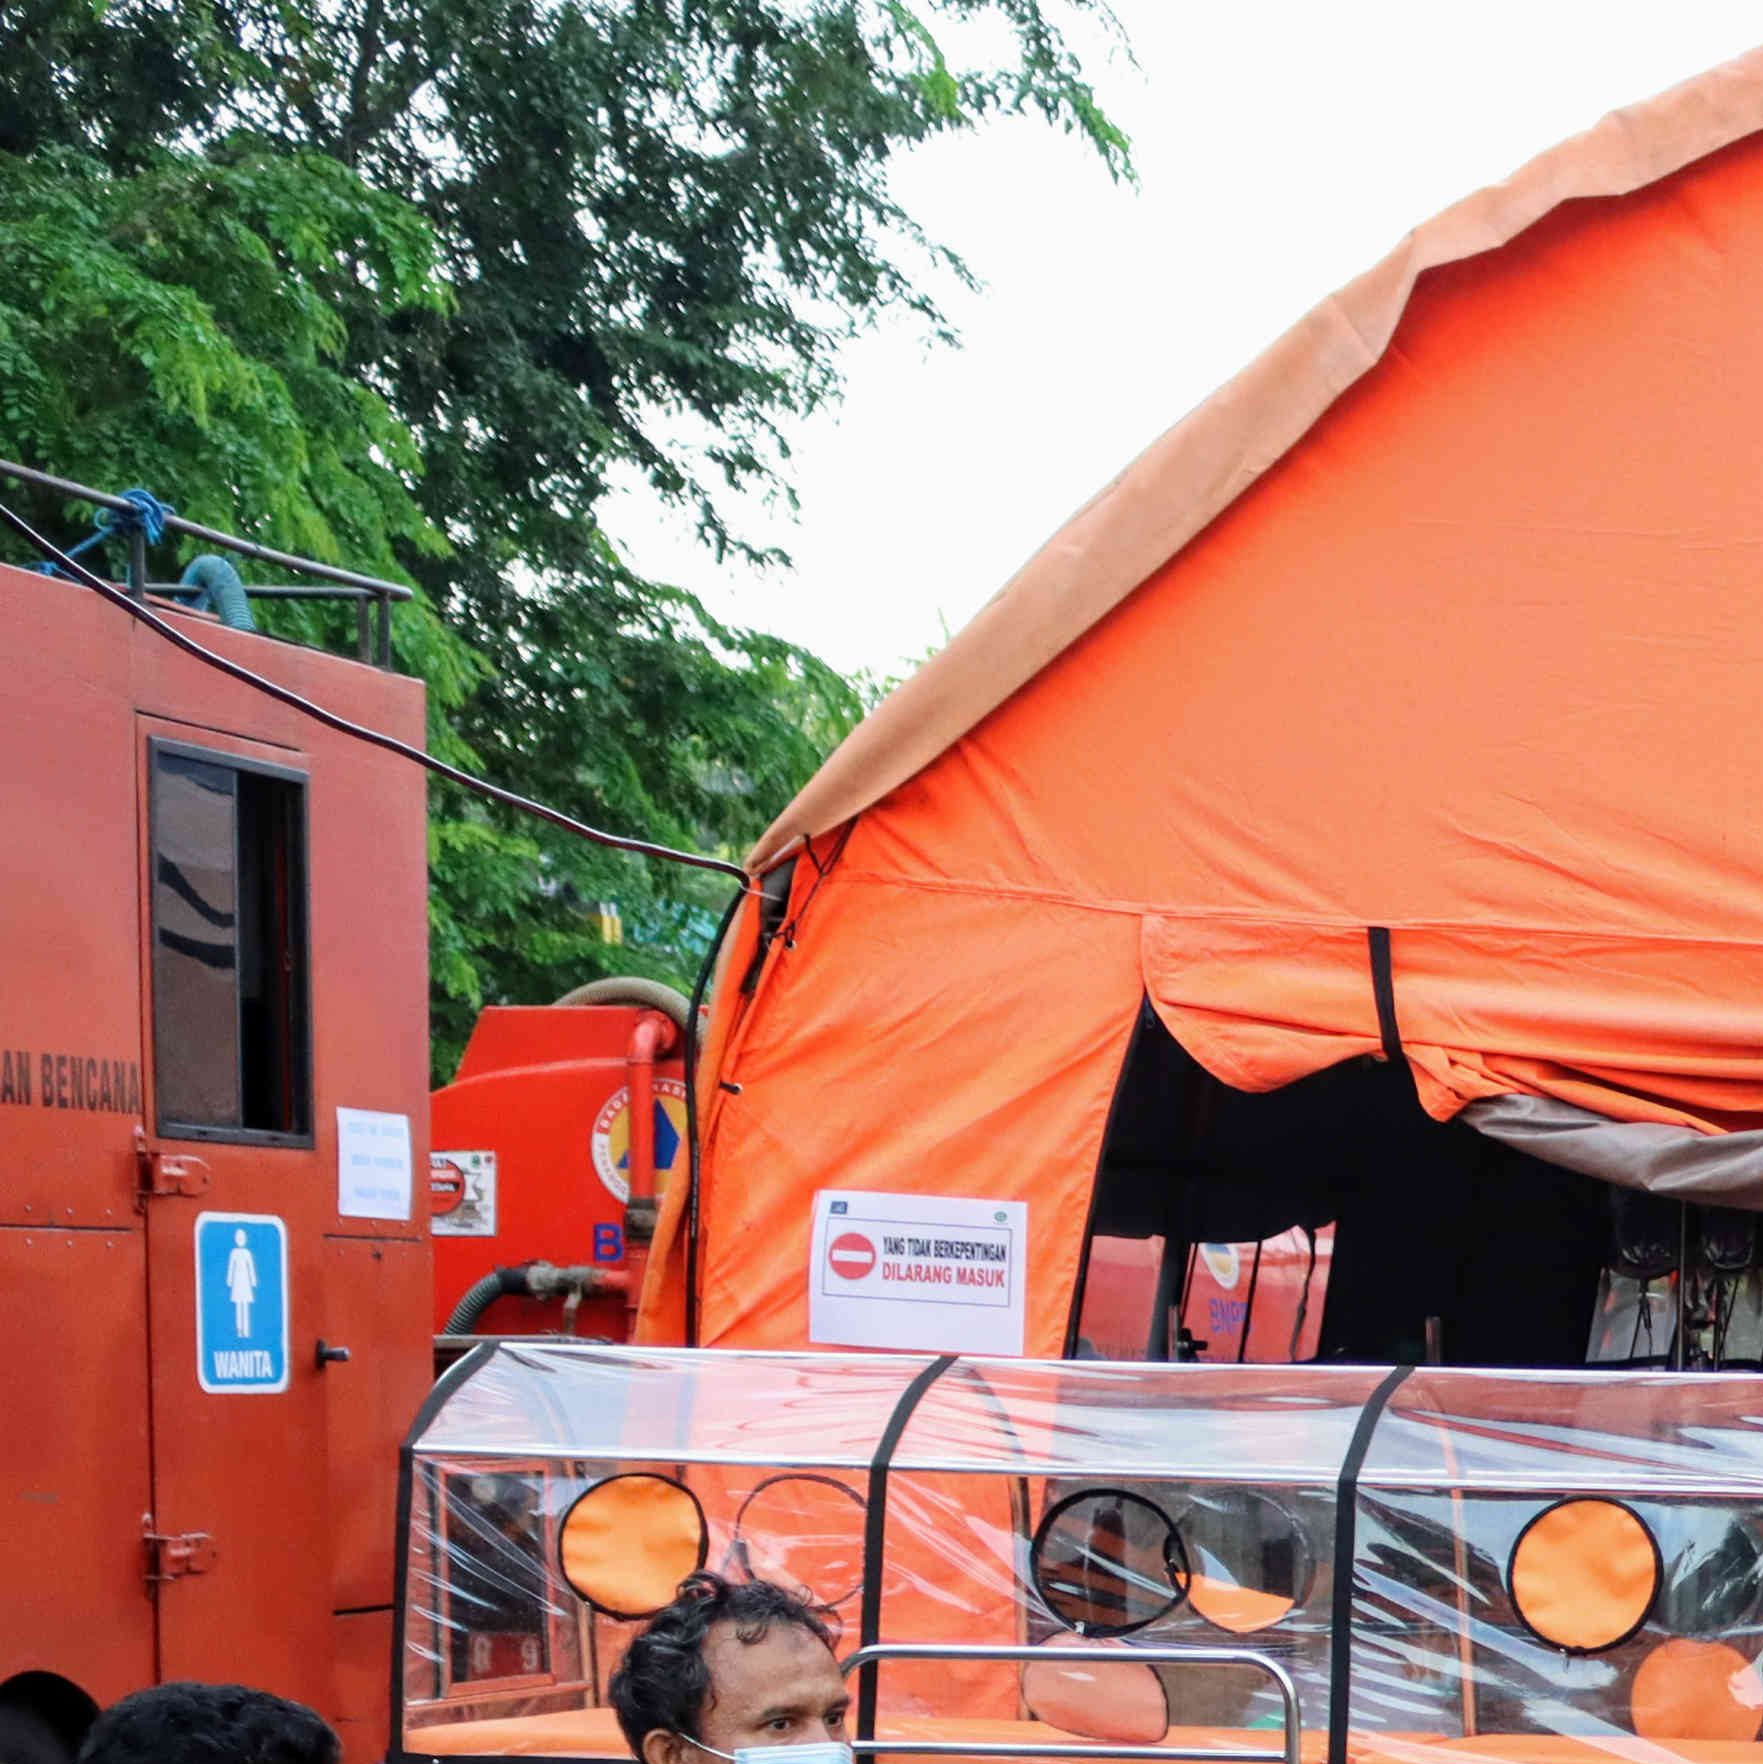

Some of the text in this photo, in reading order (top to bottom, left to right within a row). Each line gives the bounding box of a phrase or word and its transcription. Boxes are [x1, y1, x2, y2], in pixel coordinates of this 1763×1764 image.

[41, 1052, 143, 1115] BENCANA
[882, 1235, 1007, 1263] YANG TIDAK BERKEPENTINGAN
[882, 1262, 1006, 1289] DILARANG MASUK
[1210, 1298, 1249, 1334] BNP
[214, 1350, 273, 1379] WANITA
